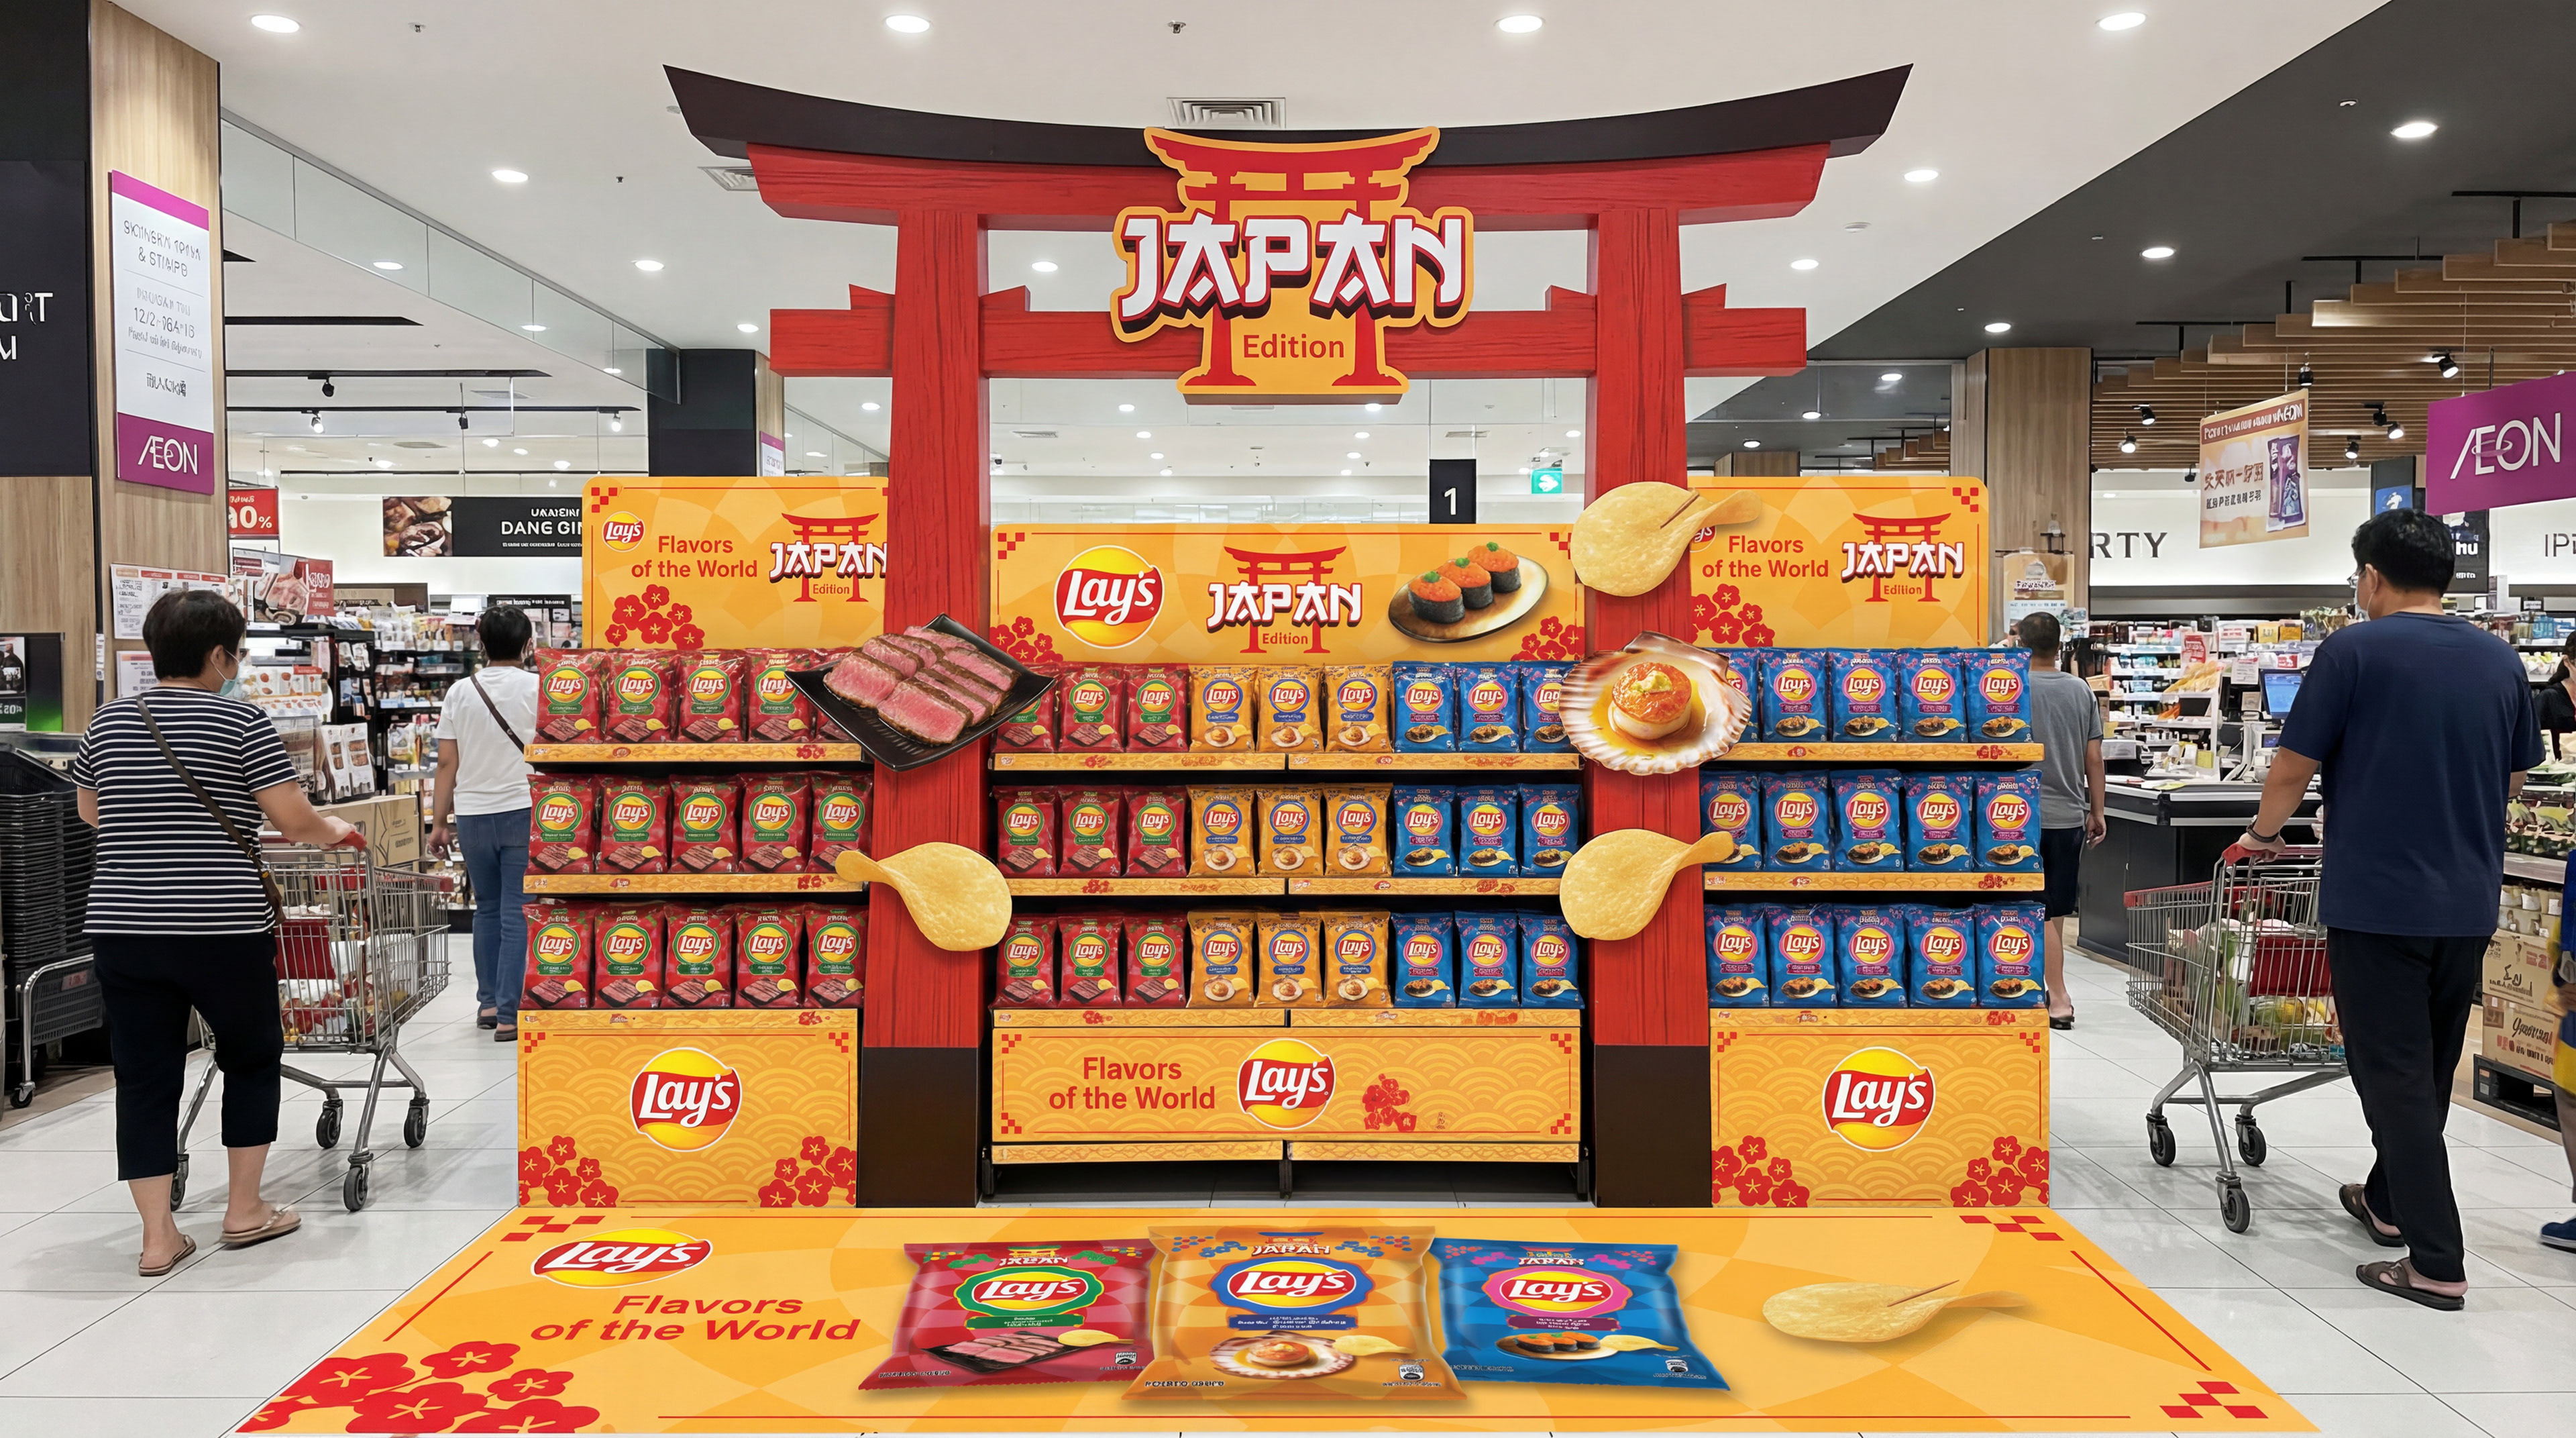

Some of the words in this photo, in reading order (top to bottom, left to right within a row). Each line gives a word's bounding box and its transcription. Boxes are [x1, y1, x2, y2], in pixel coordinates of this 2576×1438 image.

[1119, 209, 1464, 323] JAPAN
[1243, 333, 1344, 358] Edition
[1444, 487, 1456, 515] 1
[605, 521, 642, 544] Lay's
[658, 535, 734, 554] Flavors
[1729, 535, 1804, 554] Flavors
[631, 560, 654, 578] of
[657, 560, 694, 578] the
[697, 560, 758, 578] World
[769, 541, 888, 582] JAPAN
[1702, 560, 1725, 578] of
[1729, 560, 1762, 578] the
[1768, 560, 1829, 578] World
[1841, 541, 1964, 582] JAPAN
[813, 583, 850, 595] Edition
[1063, 570, 1157, 626] Lay's
[1884, 584, 1923, 595] Edition
[1206, 580, 1362, 632] JAPAN
[1263, 632, 1309, 645] Edition
[1083, 1056, 1182, 1080] Flavors
[1246, 1060, 1328, 1110] Lay's
[639, 1073, 735, 1129] Lay's
[1049, 1086, 1079, 1110] of
[1083, 1086, 1127, 1110] the
[1133, 1086, 1216, 1110] World
[1831, 1072, 1927, 1127] Lay's
[542, 1241, 704, 1274] Lay's
[979, 1279, 1082, 1302] Lay's
[1237, 1271, 1346, 1296] Lay's
[1508, 1280, 1604, 1302] Lay's
[612, 1294, 804, 1315] Flavors
[530, 1319, 594, 1341] of
[599, 1319, 686, 1341] the
[706, 1319, 861, 1341] World
